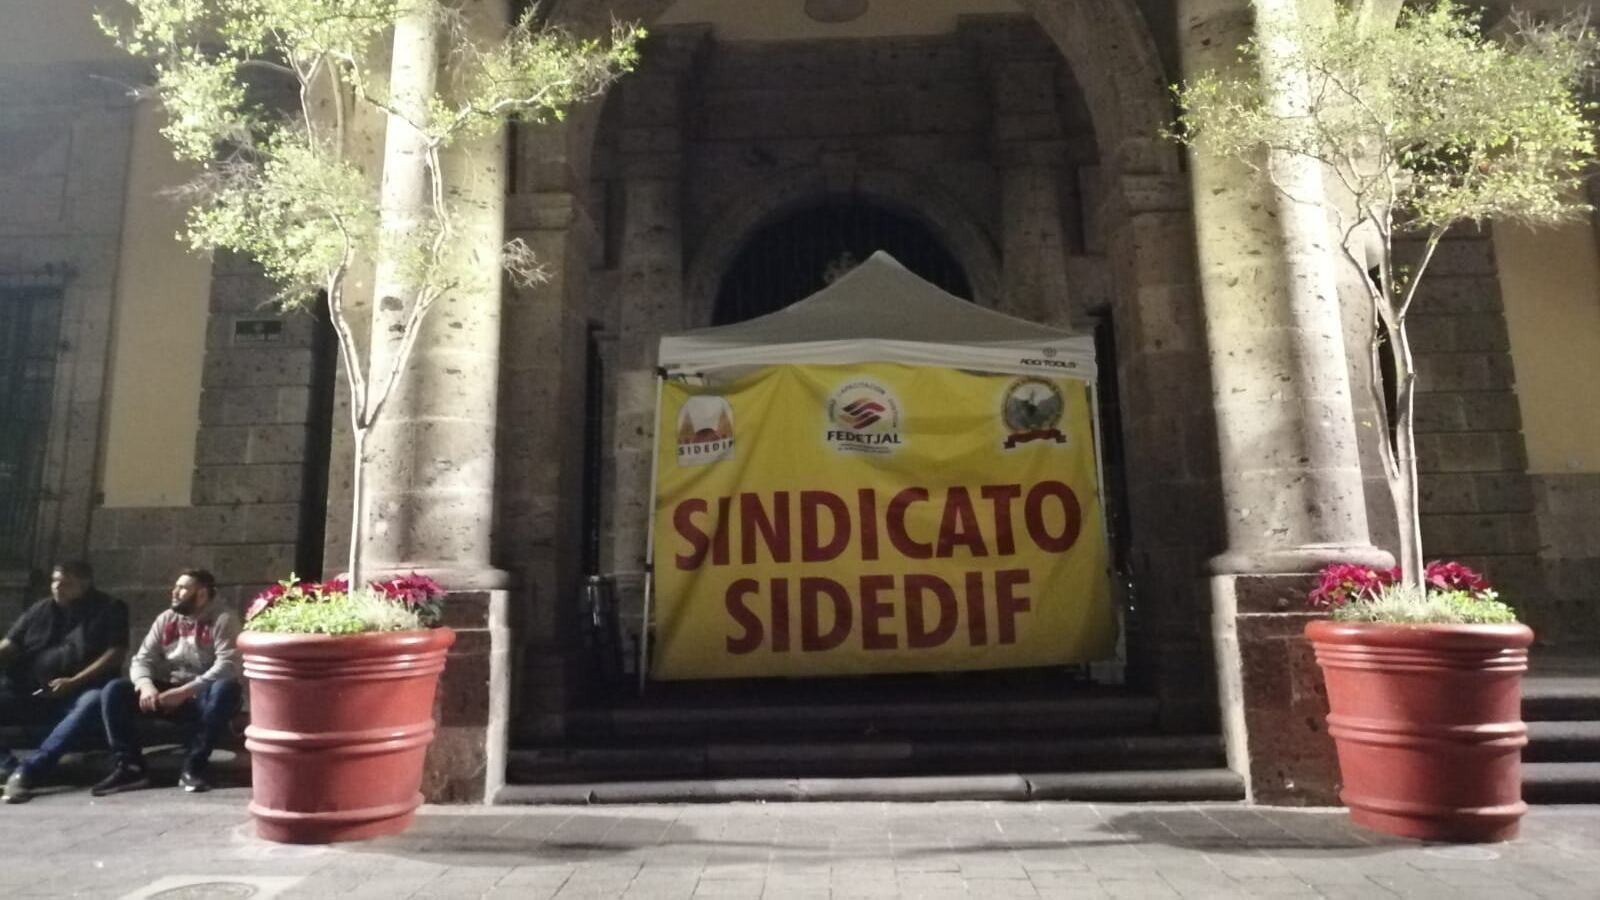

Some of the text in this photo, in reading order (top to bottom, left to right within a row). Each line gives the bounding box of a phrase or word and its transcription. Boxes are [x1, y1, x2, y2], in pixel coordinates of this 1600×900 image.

[827, 430, 902, 445] FEDETJAL
[673, 480, 1082, 571] SINDICATO
[725, 569, 1031, 655] SIDEDIF
